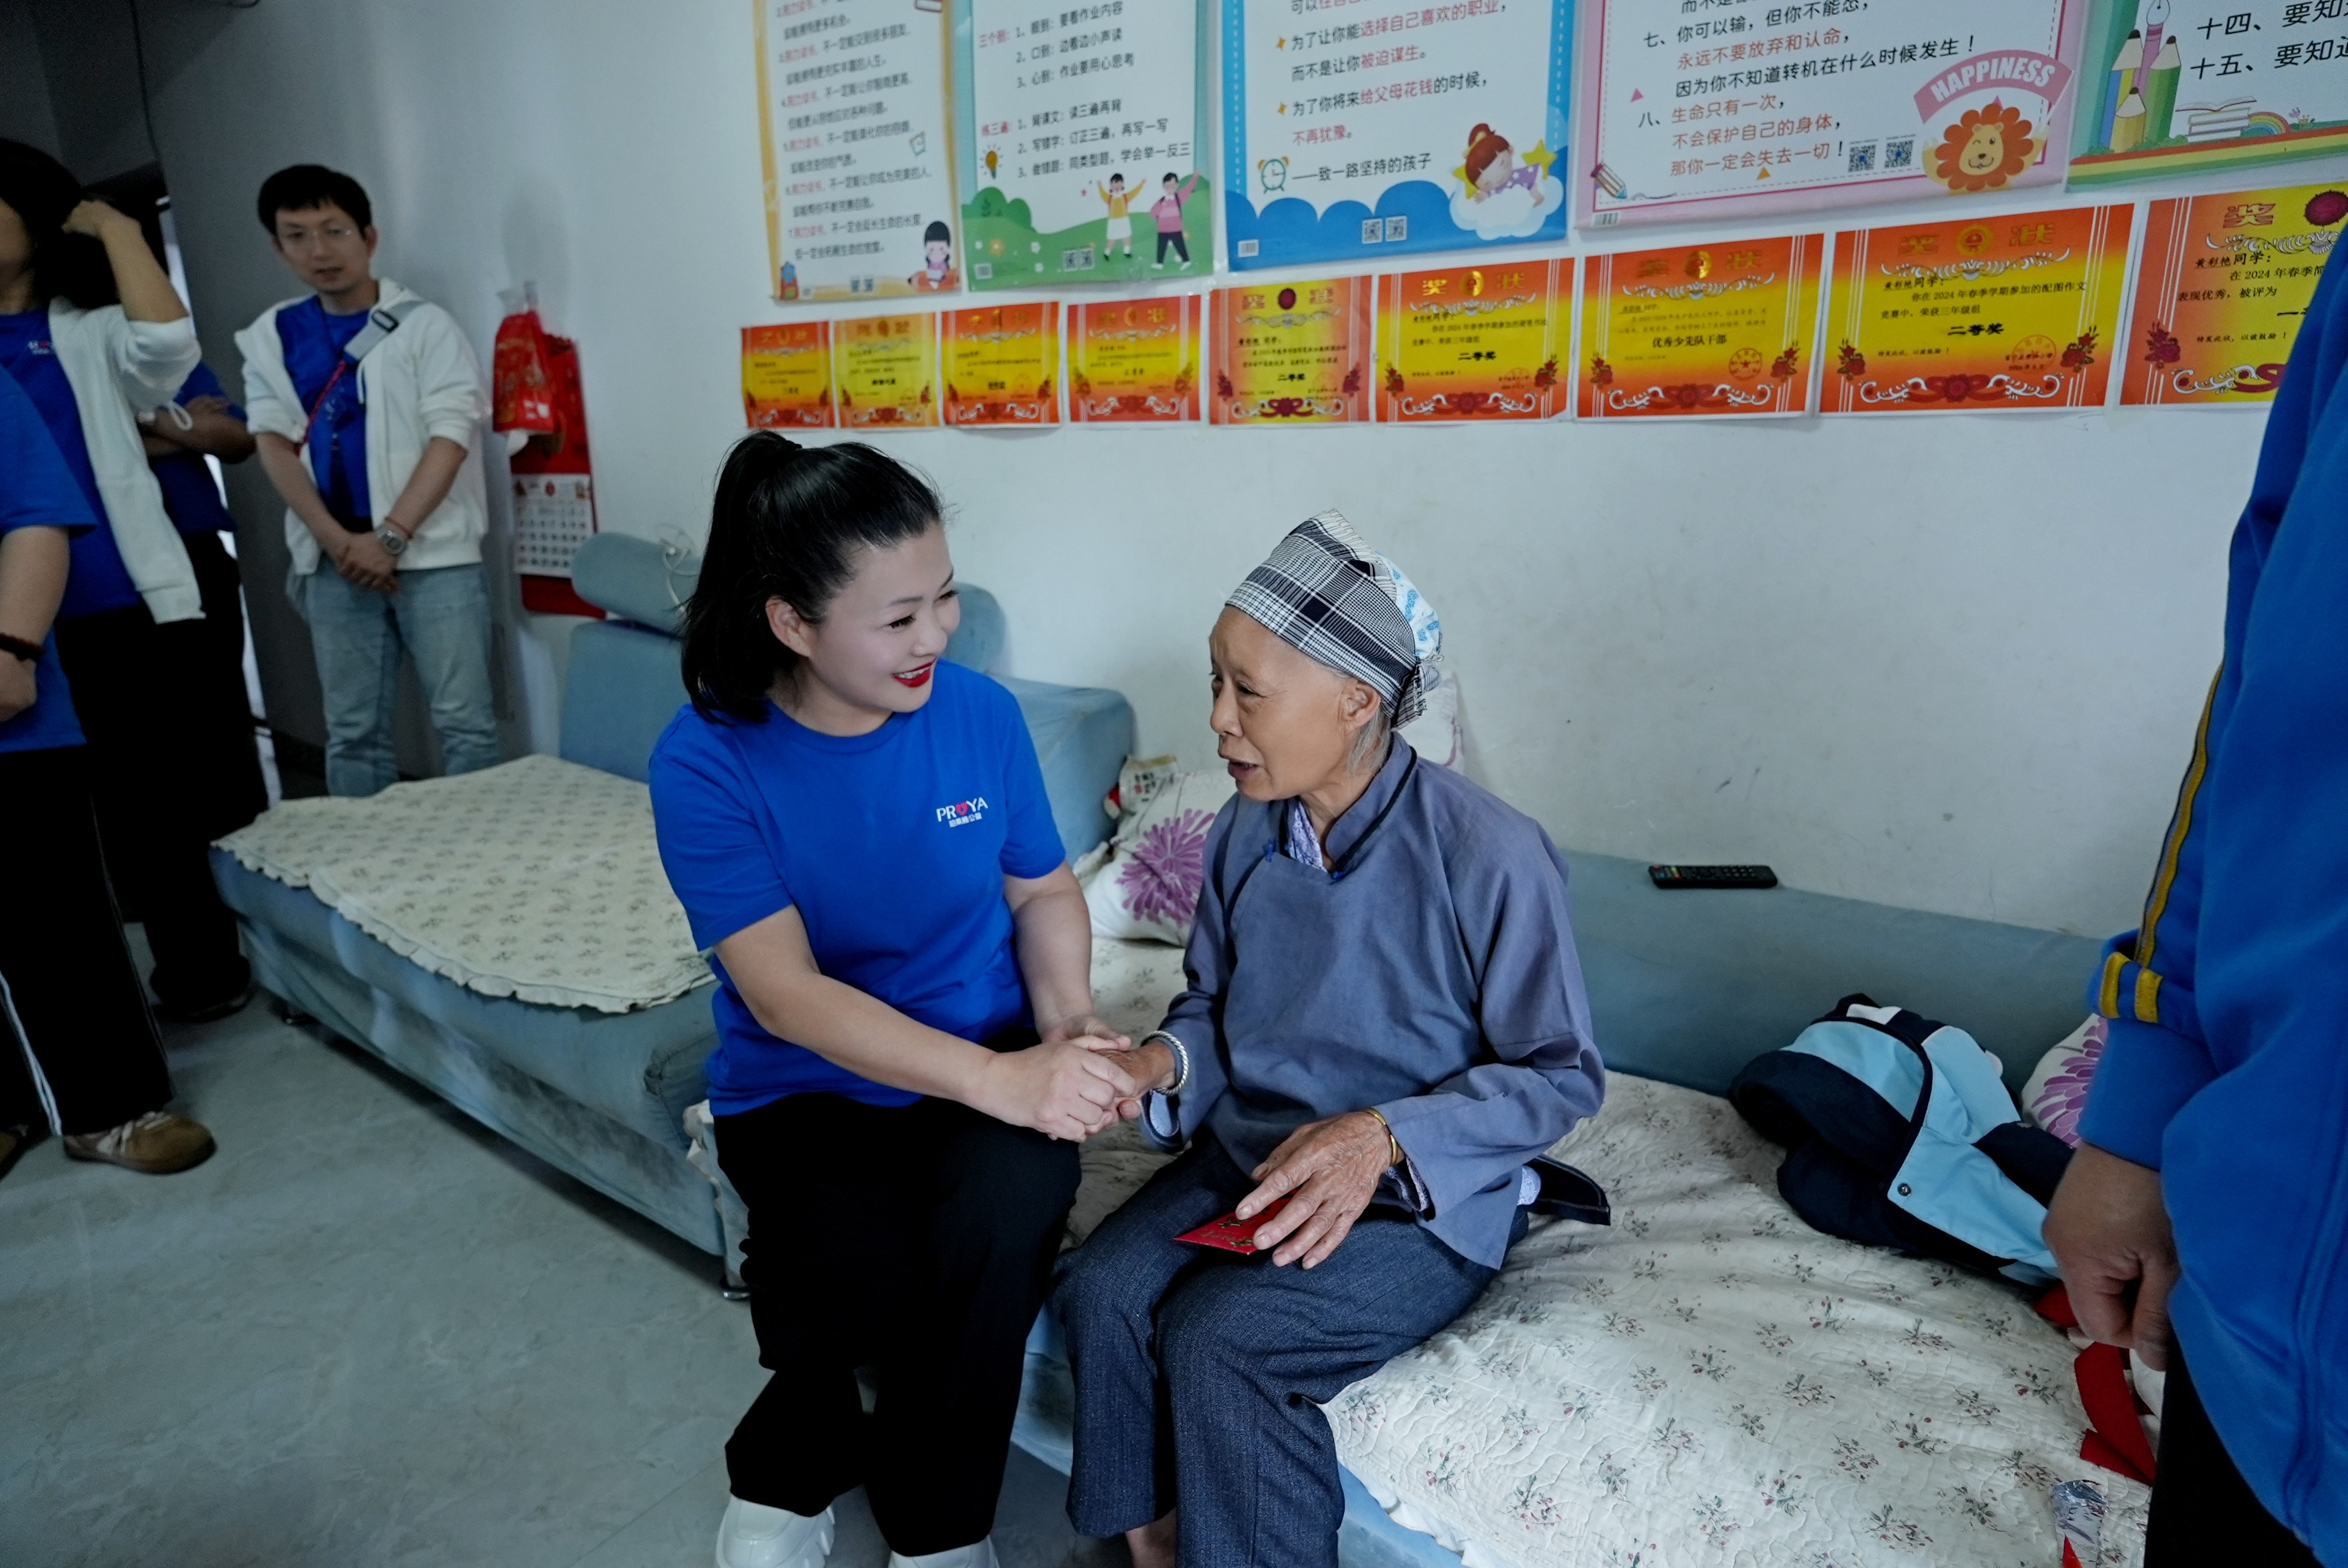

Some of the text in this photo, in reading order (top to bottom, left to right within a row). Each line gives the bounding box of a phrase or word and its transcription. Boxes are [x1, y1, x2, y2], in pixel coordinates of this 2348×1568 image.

[2197, 0, 2348, 40] 十四、要知
[1675, 35, 1974, 98] 因为你不知道转机在什么时候发生！
[1678, 27, 1850, 71] 永远不要放弃和认命，
[1293, 71, 1488, 117] 为了你将来给父母花钱的时候，
[1930, 56, 2056, 102] HAPPINESS
[1293, 125, 1353, 146] 不再犹豫。
[1673, 114, 1841, 150] 不会保护自己的身体，
[1670, 141, 1844, 177] 那你一定会失去一切！
[2245, 269, 2270, 280] 2024
[1948, 322, 2004, 337] 二等奖
[936, 797, 988, 822] PROYA
